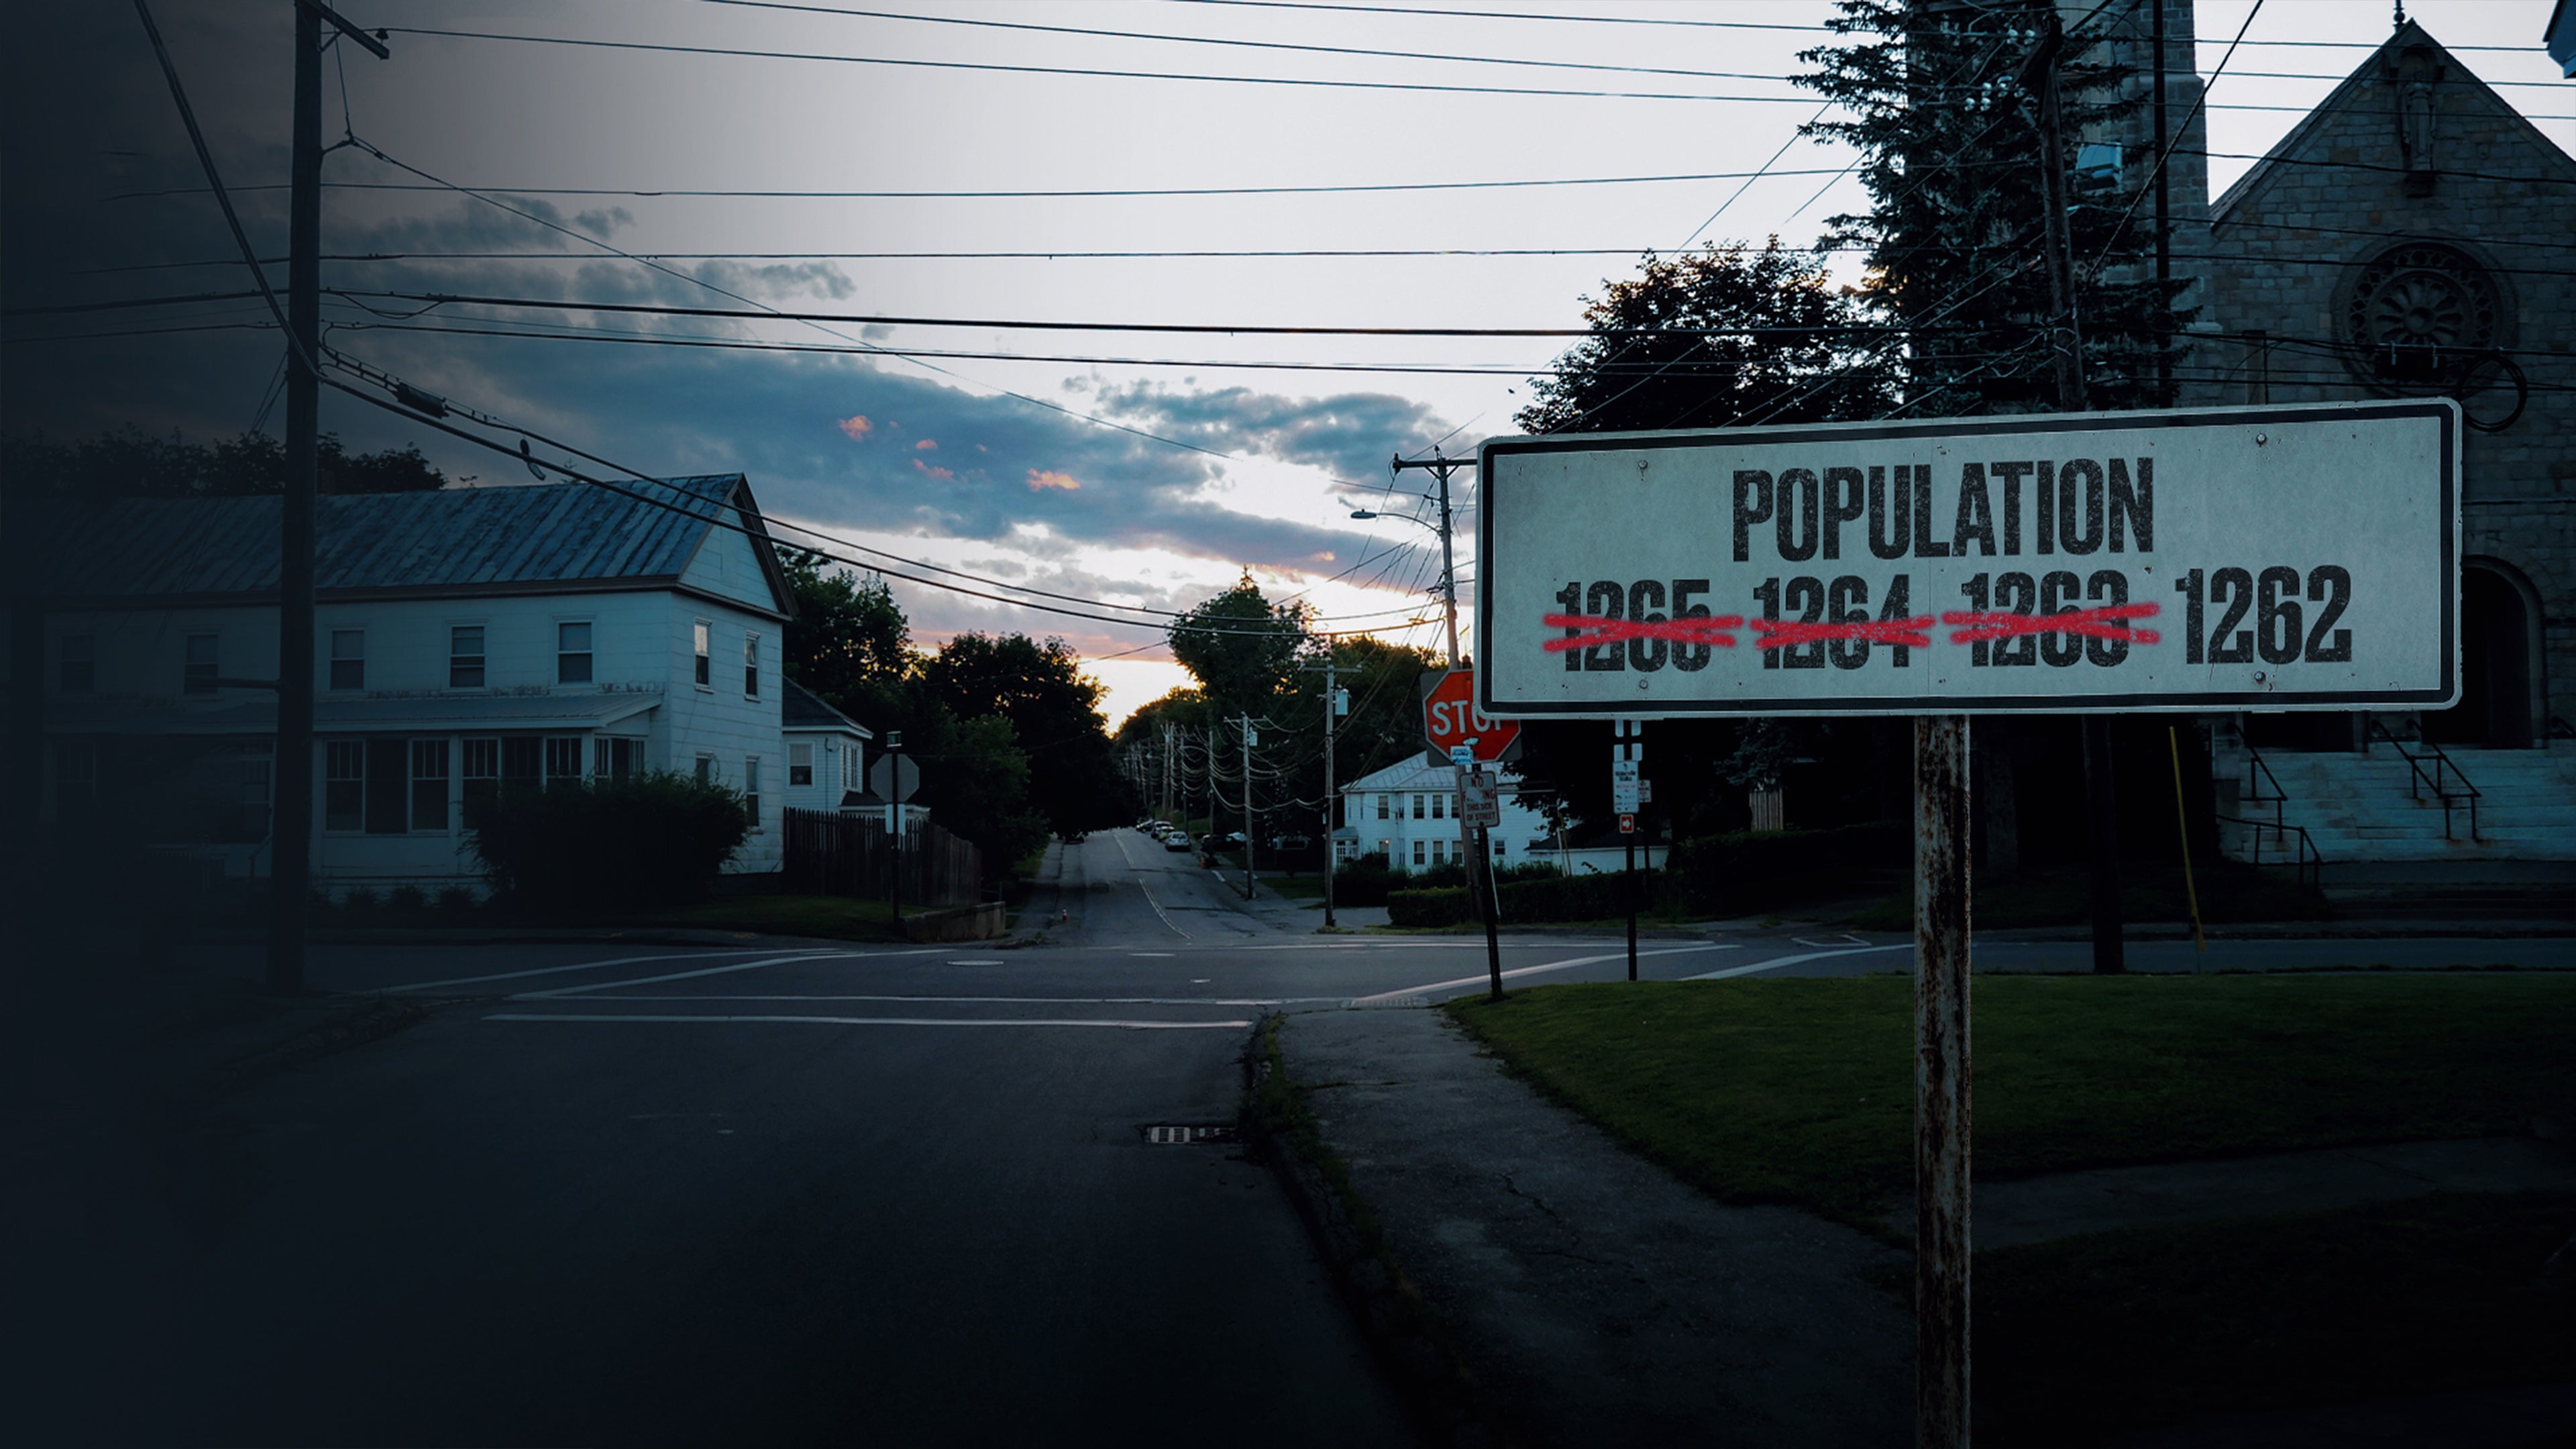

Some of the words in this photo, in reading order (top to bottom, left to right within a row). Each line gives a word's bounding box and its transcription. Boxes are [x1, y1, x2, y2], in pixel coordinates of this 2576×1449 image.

[1733, 458, 2153, 561] POPULATION
[1556, 579, 1711, 672] 1265
[1754, 574, 1910, 669] 1264
[1961, 570, 2129, 667] 1263
[2175, 565, 2352, 665] 1262
[1470, 776, 1484, 788] NO
[1475, 812, 1495, 820] STREET
